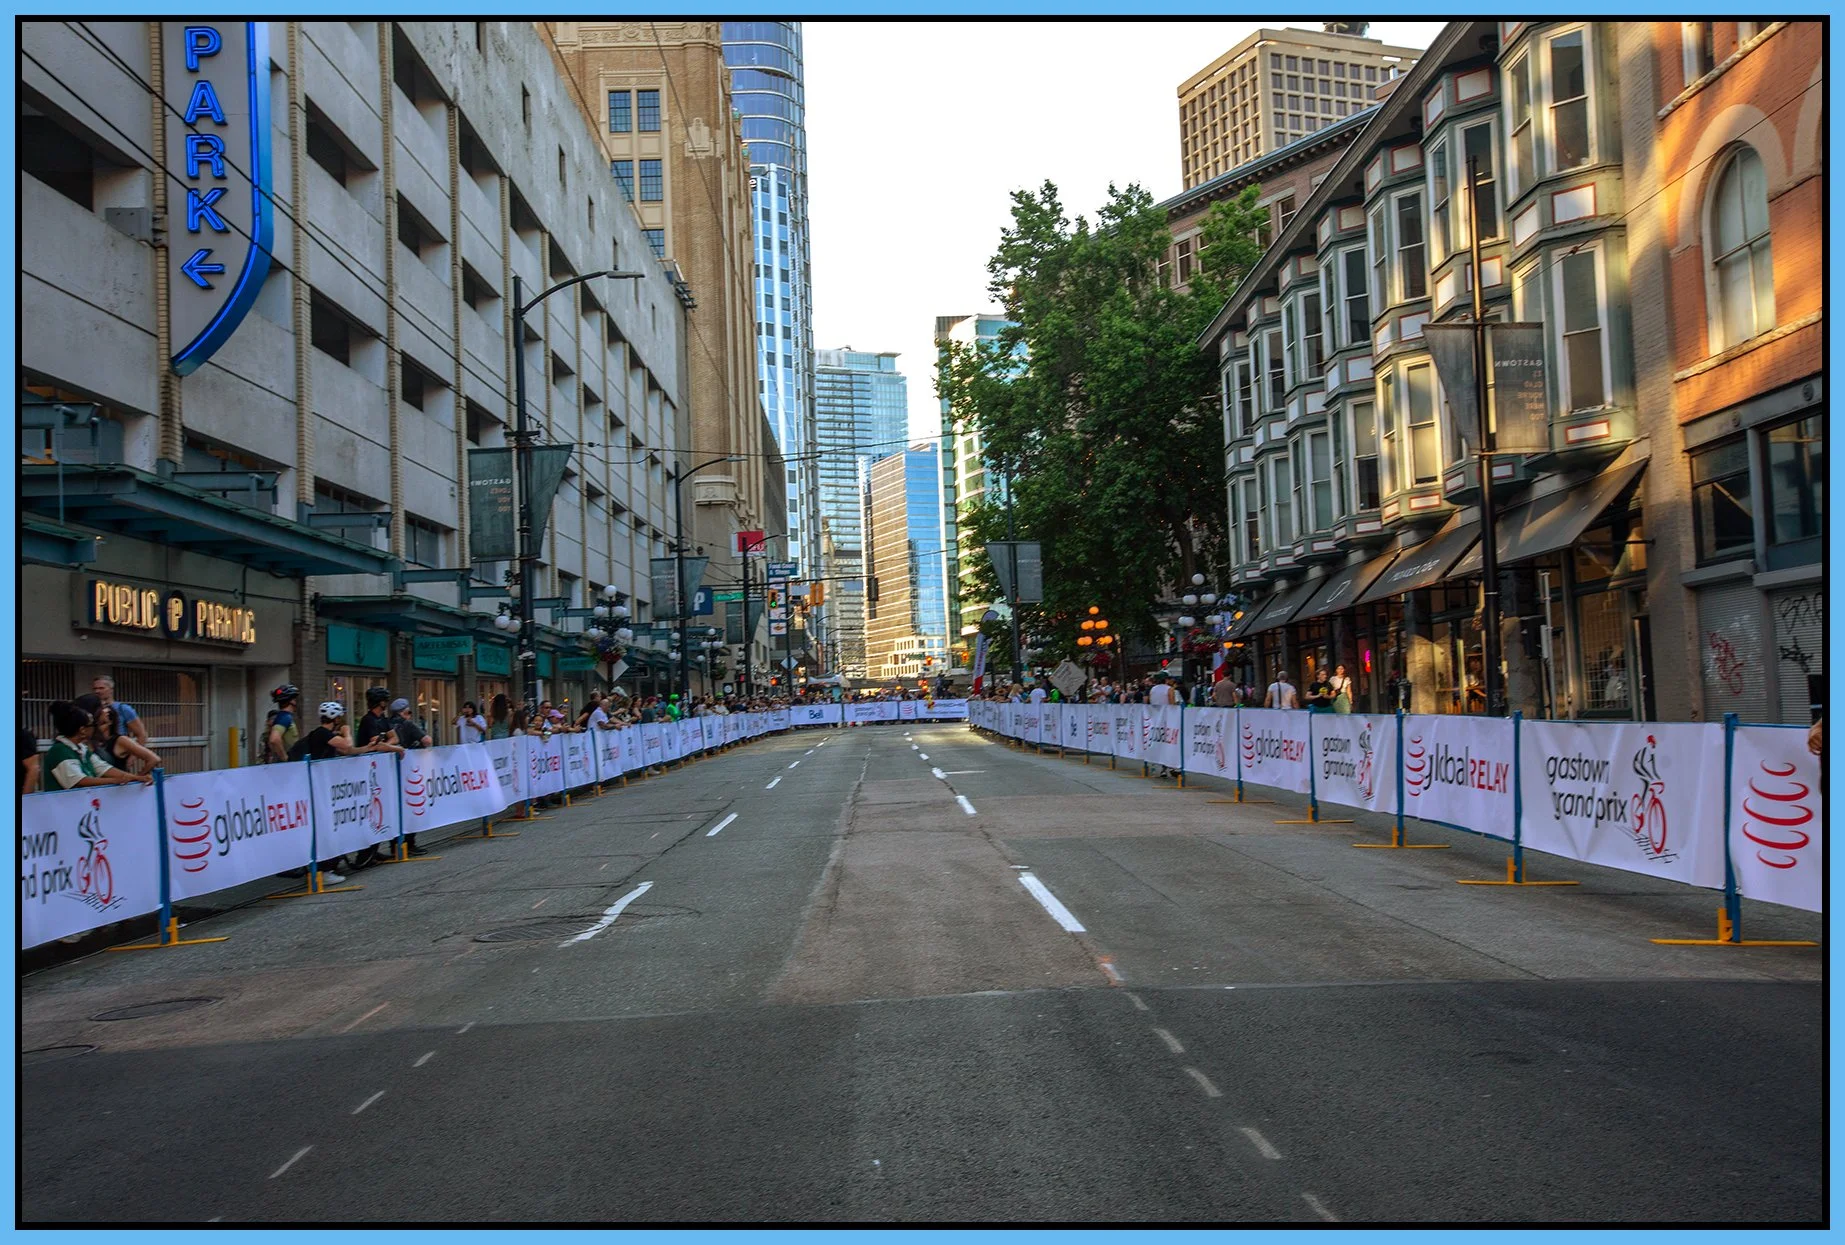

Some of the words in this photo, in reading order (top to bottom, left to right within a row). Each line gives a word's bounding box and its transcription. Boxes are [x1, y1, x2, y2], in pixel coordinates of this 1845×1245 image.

[184, 25, 230, 235] PARK
[94, 580, 160, 630] PUBLIC
[196, 599, 257, 644] PARKING
[693, 591, 706, 611] P
[808, 709, 824, 720] Bell
[1256, 729, 1306, 763] globalRELAY
[426, 765, 489, 807] globalRELAY
[1545, 751, 1611, 786] gastown
[214, 795, 309, 858] globalRELAY
[1552, 789, 1594, 821] grand
[1594, 792, 1629, 828] prix
[42, 860, 74, 904] prix
